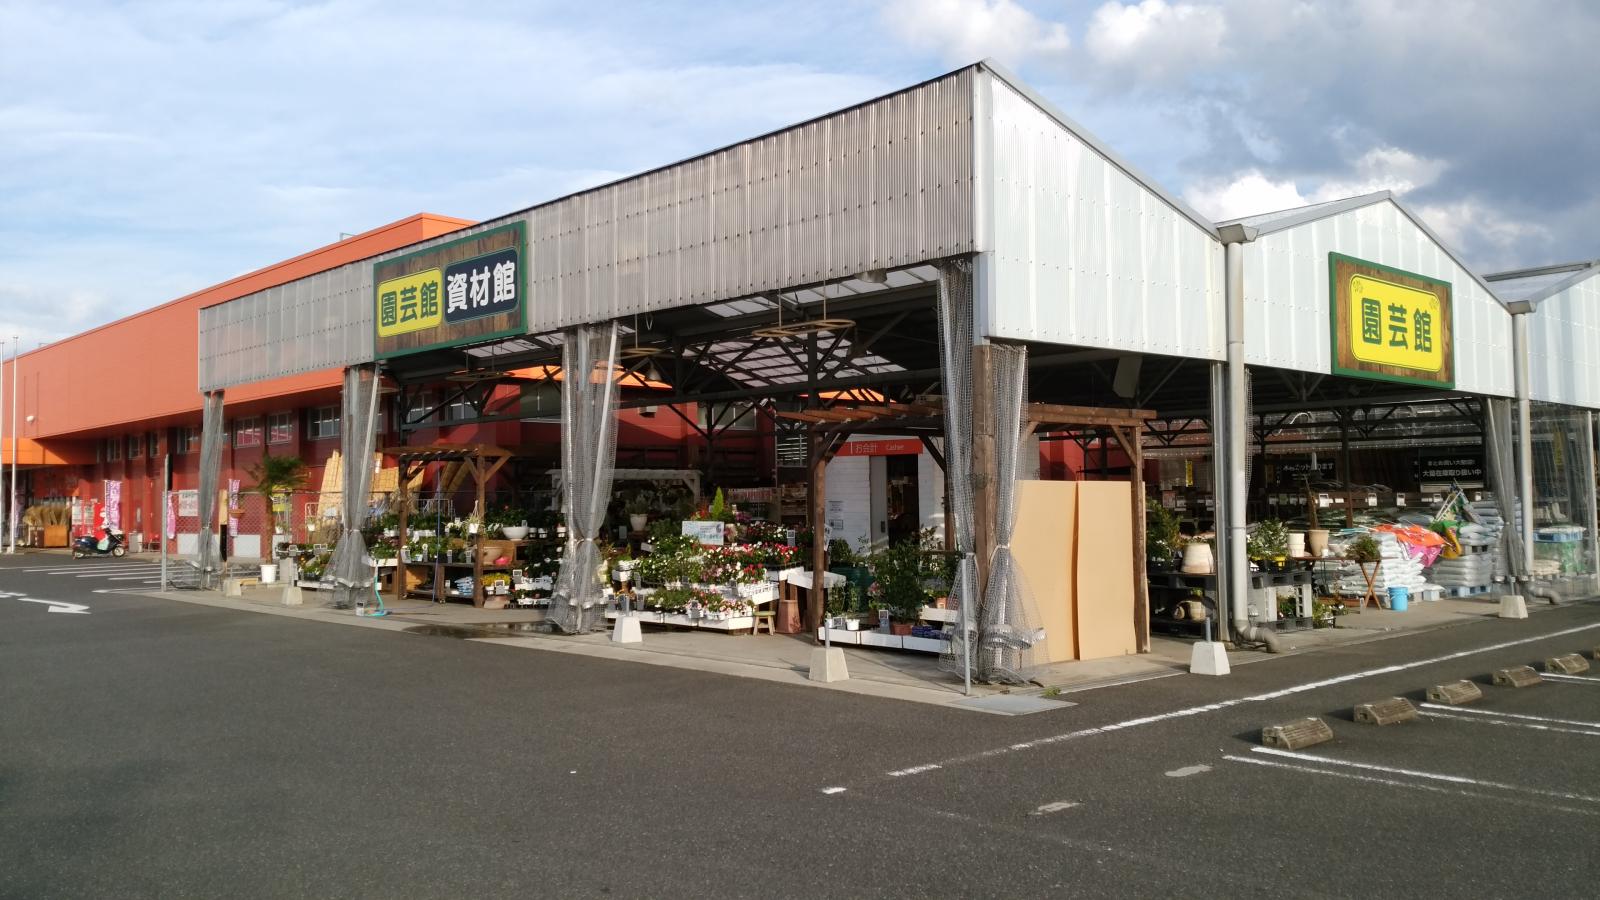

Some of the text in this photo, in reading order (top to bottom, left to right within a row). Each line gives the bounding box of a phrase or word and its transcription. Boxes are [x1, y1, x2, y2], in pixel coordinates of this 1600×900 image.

[381, 260, 516, 327] 園芸館 資材館
[1361, 297, 1433, 353] 園芸館
[856, 442, 878, 454] お会計
